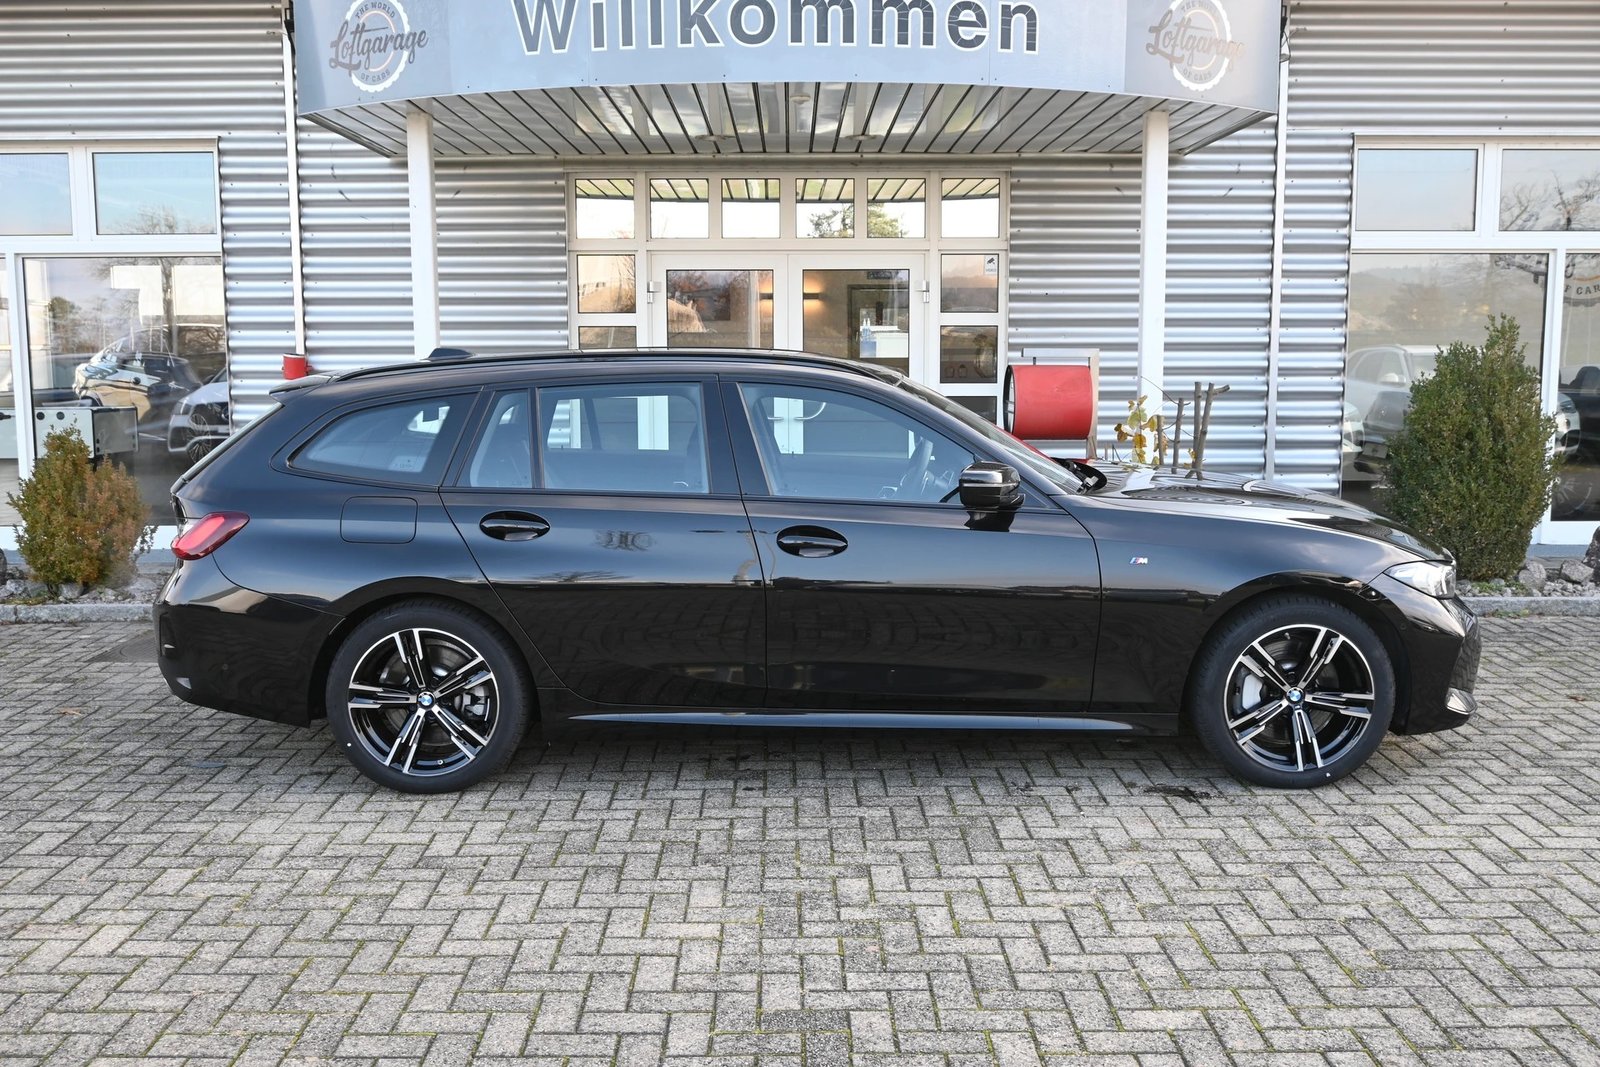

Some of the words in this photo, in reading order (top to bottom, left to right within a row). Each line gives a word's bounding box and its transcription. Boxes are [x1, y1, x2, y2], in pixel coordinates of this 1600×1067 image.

[355, 3, 369, 19] THE
[371, 1, 396, 18] WORLD
[511, 0, 1039, 55] Willkommen
[329, 20, 429, 77] Loftgarage
[361, 72, 370, 81] OF
[371, 68, 391, 82] CARS
